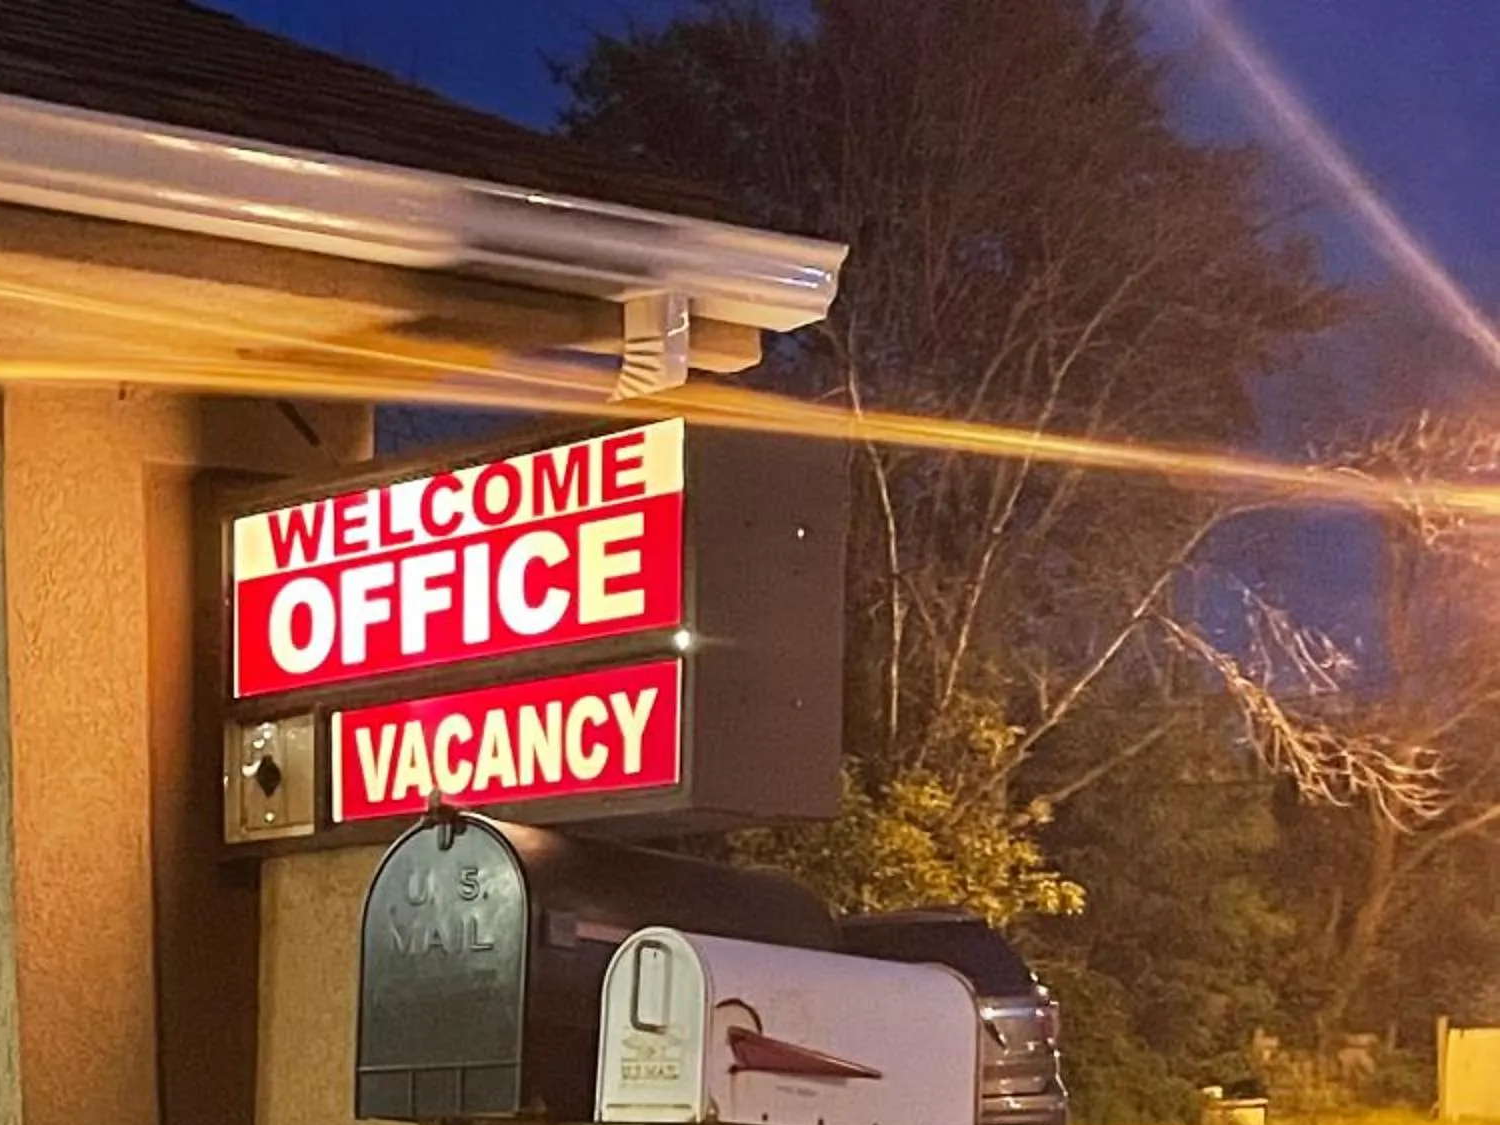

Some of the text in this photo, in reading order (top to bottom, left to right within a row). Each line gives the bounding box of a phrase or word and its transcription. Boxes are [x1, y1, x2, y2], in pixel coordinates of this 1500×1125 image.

[267, 432, 646, 569] WELCOME
[268, 512, 645, 675] OFFICE
[355, 687, 659, 803] VACANCY
